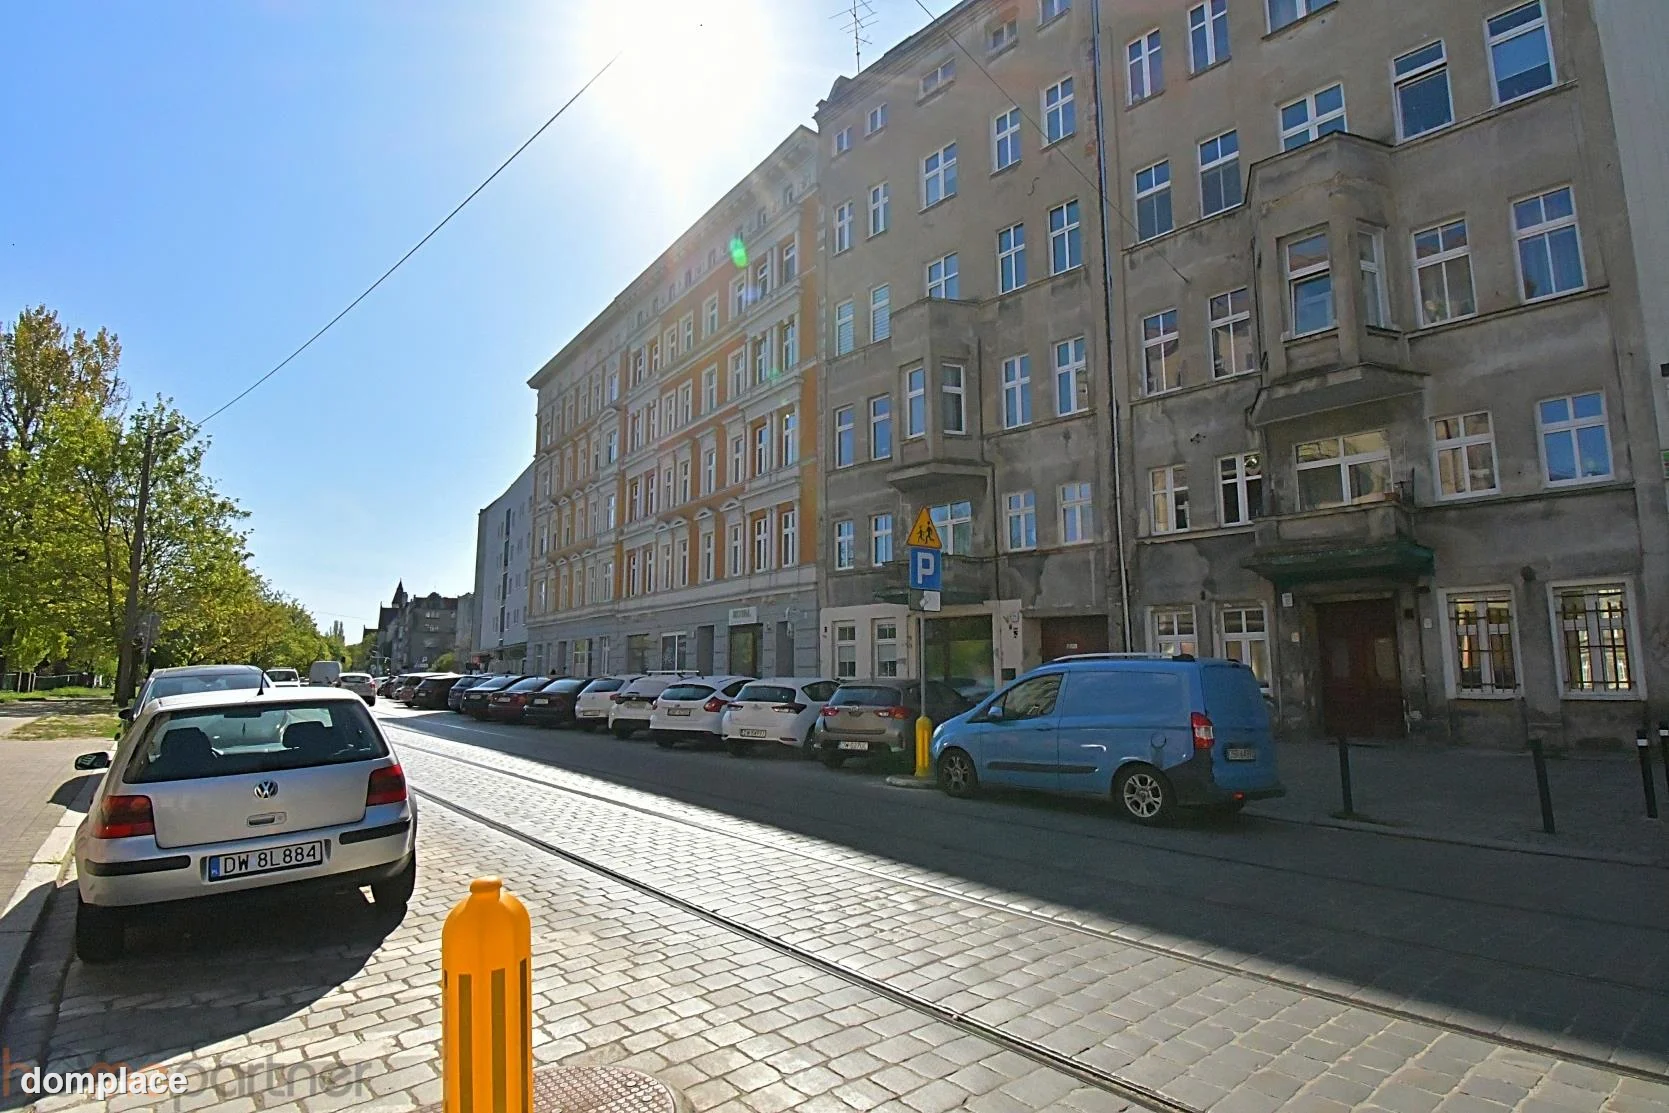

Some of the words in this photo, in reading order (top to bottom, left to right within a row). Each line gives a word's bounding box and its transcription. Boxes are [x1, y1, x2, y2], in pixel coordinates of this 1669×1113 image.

[917, 551, 935, 585] P
[223, 854, 249, 874] DW
[257, 844, 316, 868] 8L884
